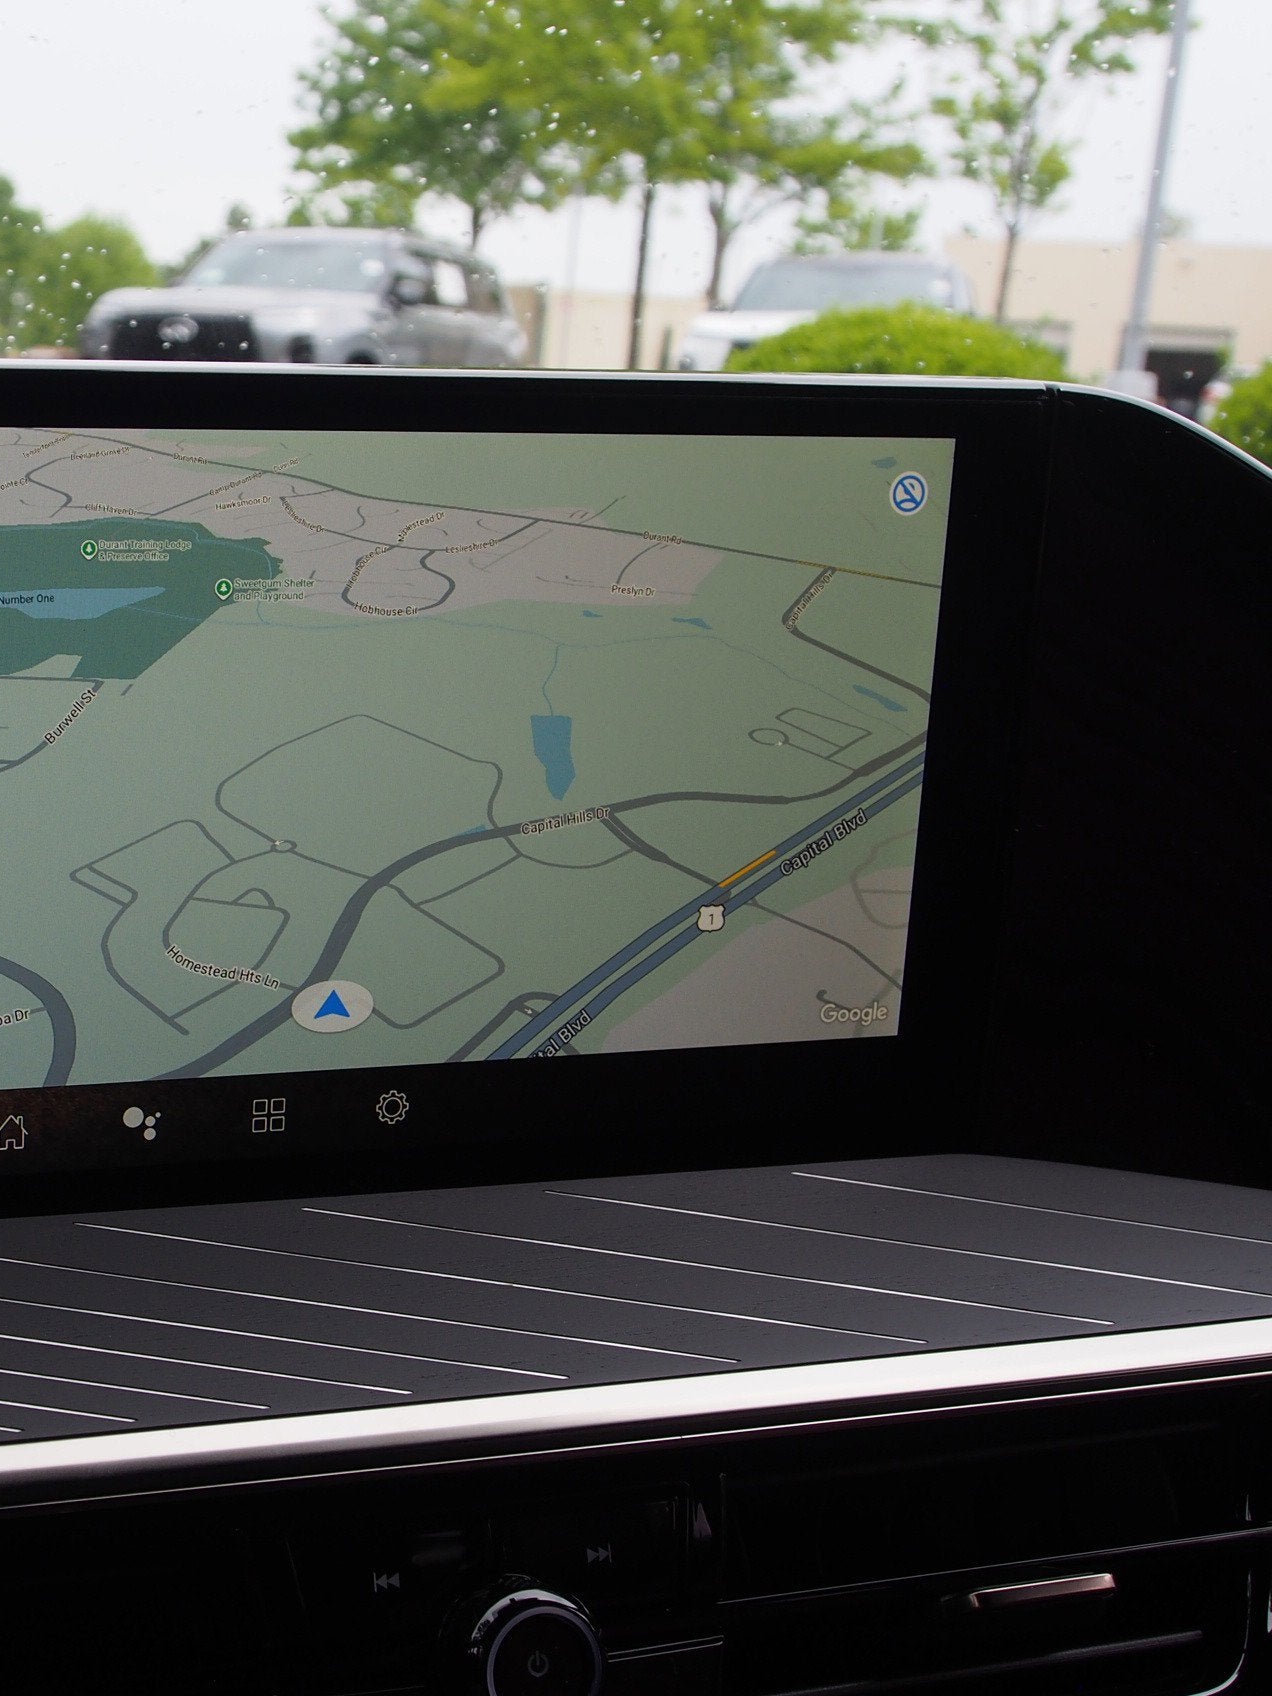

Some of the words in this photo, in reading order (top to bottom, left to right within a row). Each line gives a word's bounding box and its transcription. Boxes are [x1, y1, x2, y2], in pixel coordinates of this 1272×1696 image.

[215, 498, 262, 510] Hawksmoor
[262, 496, 271, 504] Dr
[103, 505, 127, 515] Haven
[128, 507, 138, 516] Dr
[436, 510, 446, 520] Dr
[316, 524, 326, 534] Dr
[643, 531, 669, 543] Durant
[671, 535, 682, 545] Rd
[99, 540, 128, 549] Durant
[129, 540, 164, 551] Training
[165, 540, 192, 551] Lodge
[99, 553, 106, 561] &
[107, 552, 144, 561] Preserve
[145, 552, 169, 561] Office
[345, 552, 375, 589] Hobhouse
[374, 547, 389, 556] Cir
[234, 579, 282, 590] Sweetgum
[283, 578, 315, 588] Shelter
[611, 584, 643, 598] Preslyn
[645, 586, 656, 596] Dr
[36, 594, 55, 604] One
[234, 592, 252, 600] and
[254, 591, 304, 603] Playground
[786, 599, 809, 631] Capital
[807, 582, 825, 602] Hills
[823, 573, 834, 584] Dr
[354, 602, 403, 617] Hobhouse
[405, 605, 419, 616] Cir
[44, 703, 81, 745] Burwell
[79, 688, 97, 706] St
[521, 815, 565, 836] Capital
[566, 811, 594, 827] Hills
[594, 806, 611, 821] Dr
[780, 832, 834, 877] Capital
[831, 809, 868, 842] Blvd
[709, 913, 715, 926] 1
[166, 945, 237, 981] Homestead
[238, 967, 262, 985] Hts
[263, 972, 280, 989] Ln
[14, 1007, 30, 1022] Dr
[820, 1002, 889, 1027] Google
[557, 1010, 592, 1044] Blvd
